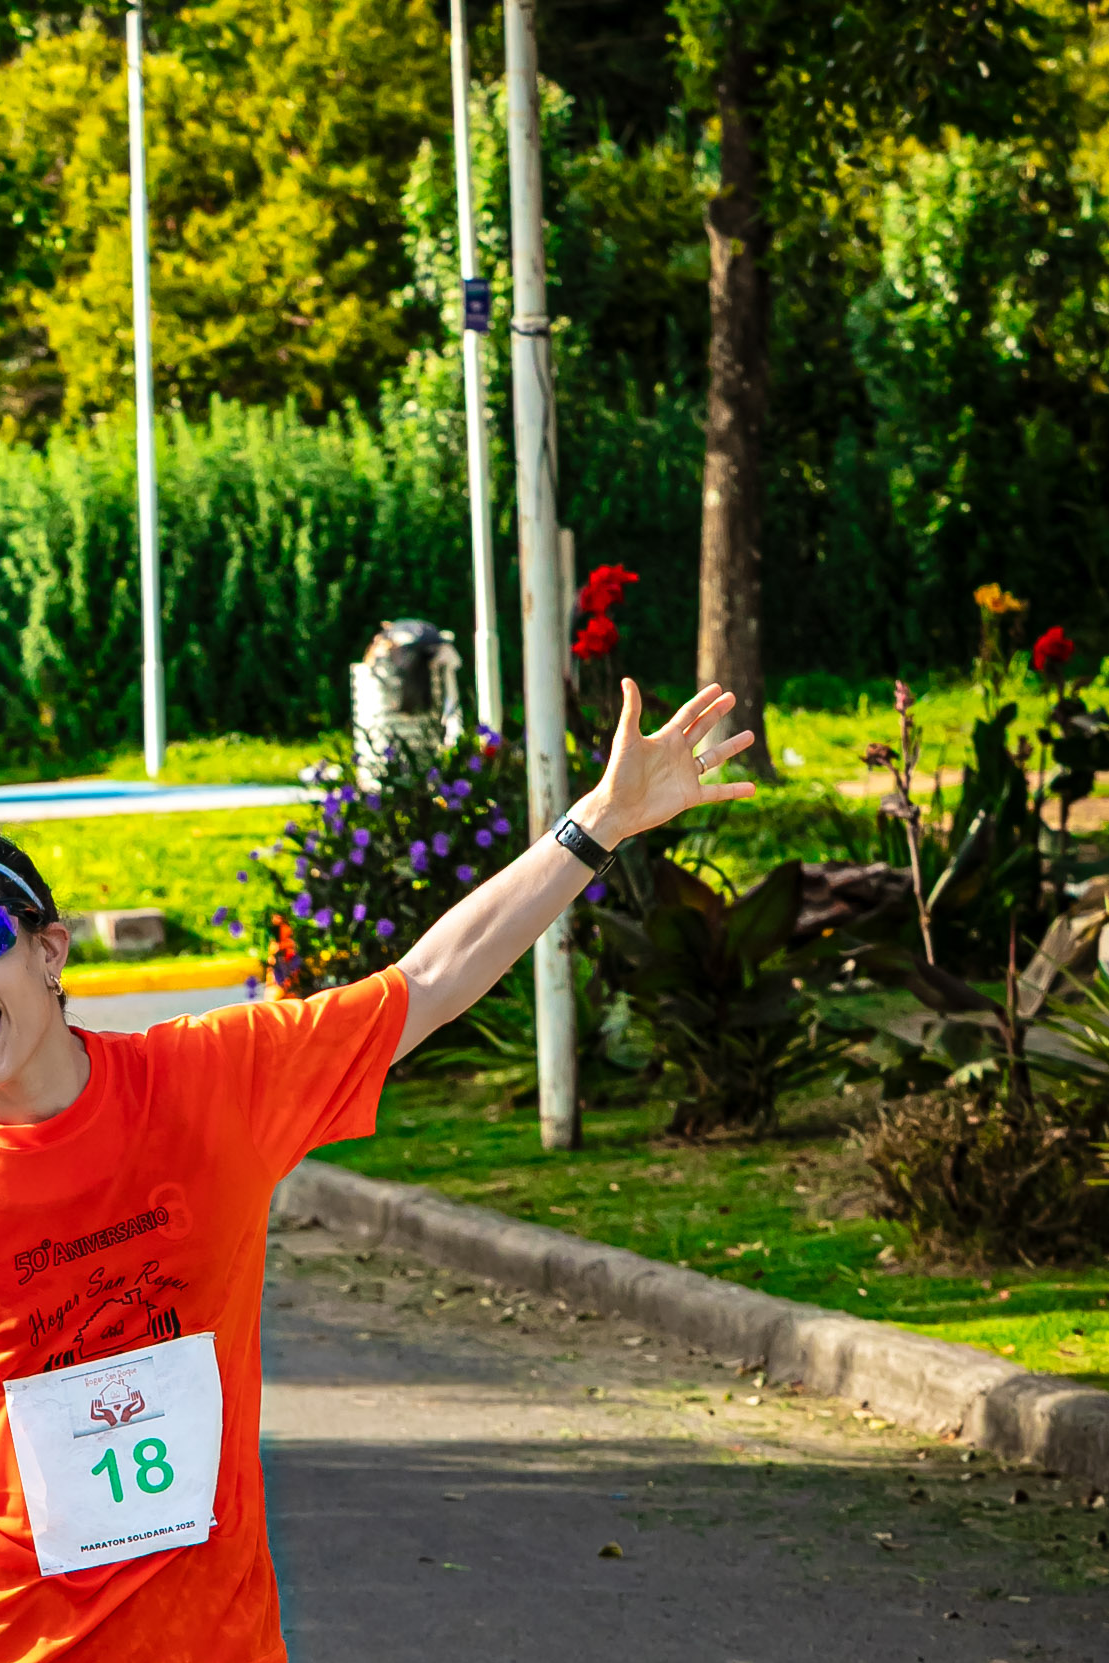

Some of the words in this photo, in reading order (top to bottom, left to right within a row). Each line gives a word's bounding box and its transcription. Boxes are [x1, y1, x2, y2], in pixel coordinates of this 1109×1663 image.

[28, 1294, 80, 1347] Hogar
[86, 1266, 126, 1298] San
[134, 1260, 189, 1293] Roque
[91, 1437, 174, 1503] 18
[80, 1538, 126, 1553] MARATON
[127, 1526, 174, 1543] SOLIDARIA
[175, 1520, 196, 1532] 2025
